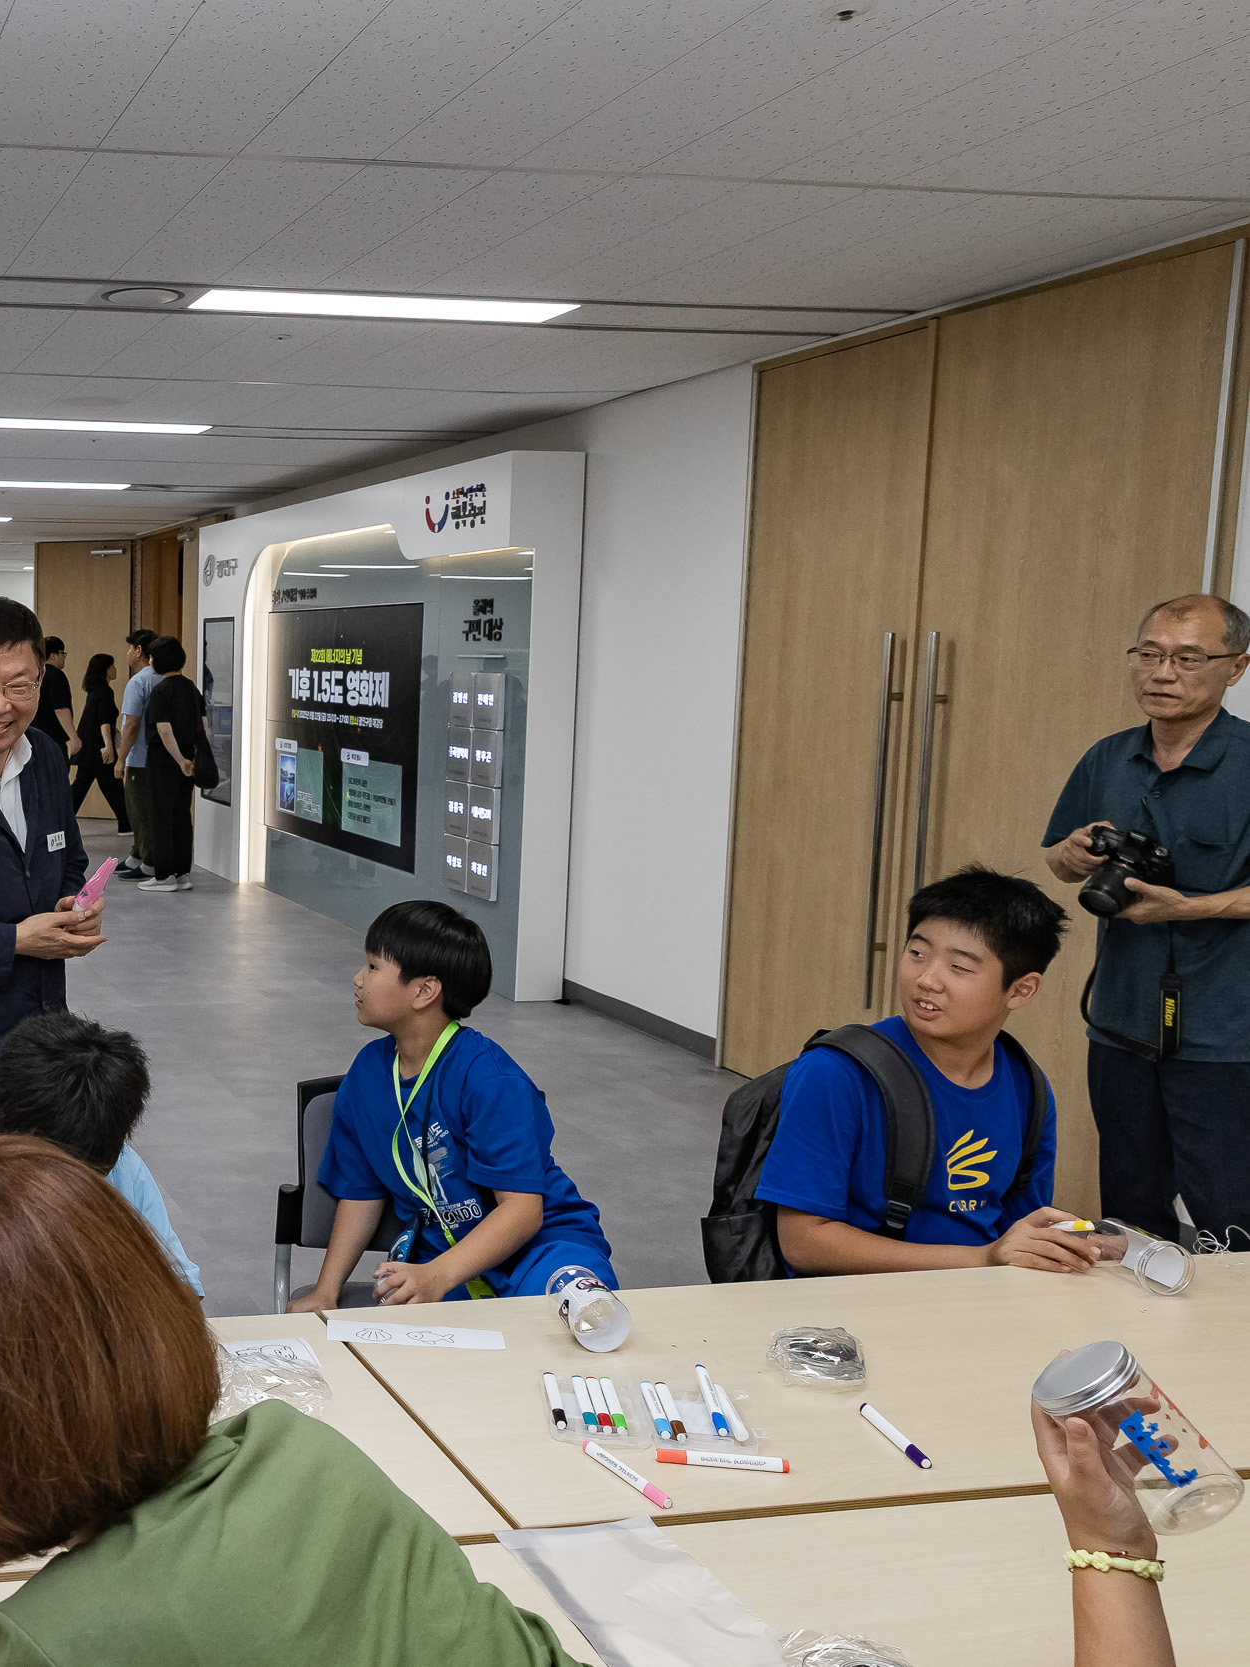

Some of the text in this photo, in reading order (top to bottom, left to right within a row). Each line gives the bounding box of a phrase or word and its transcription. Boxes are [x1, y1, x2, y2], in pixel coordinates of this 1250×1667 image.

[462, 617, 504, 642] 구민 대상
[288, 667, 390, 708] 기후 1.5도 영화제
[1165, 997, 1175, 1026] Nikon
